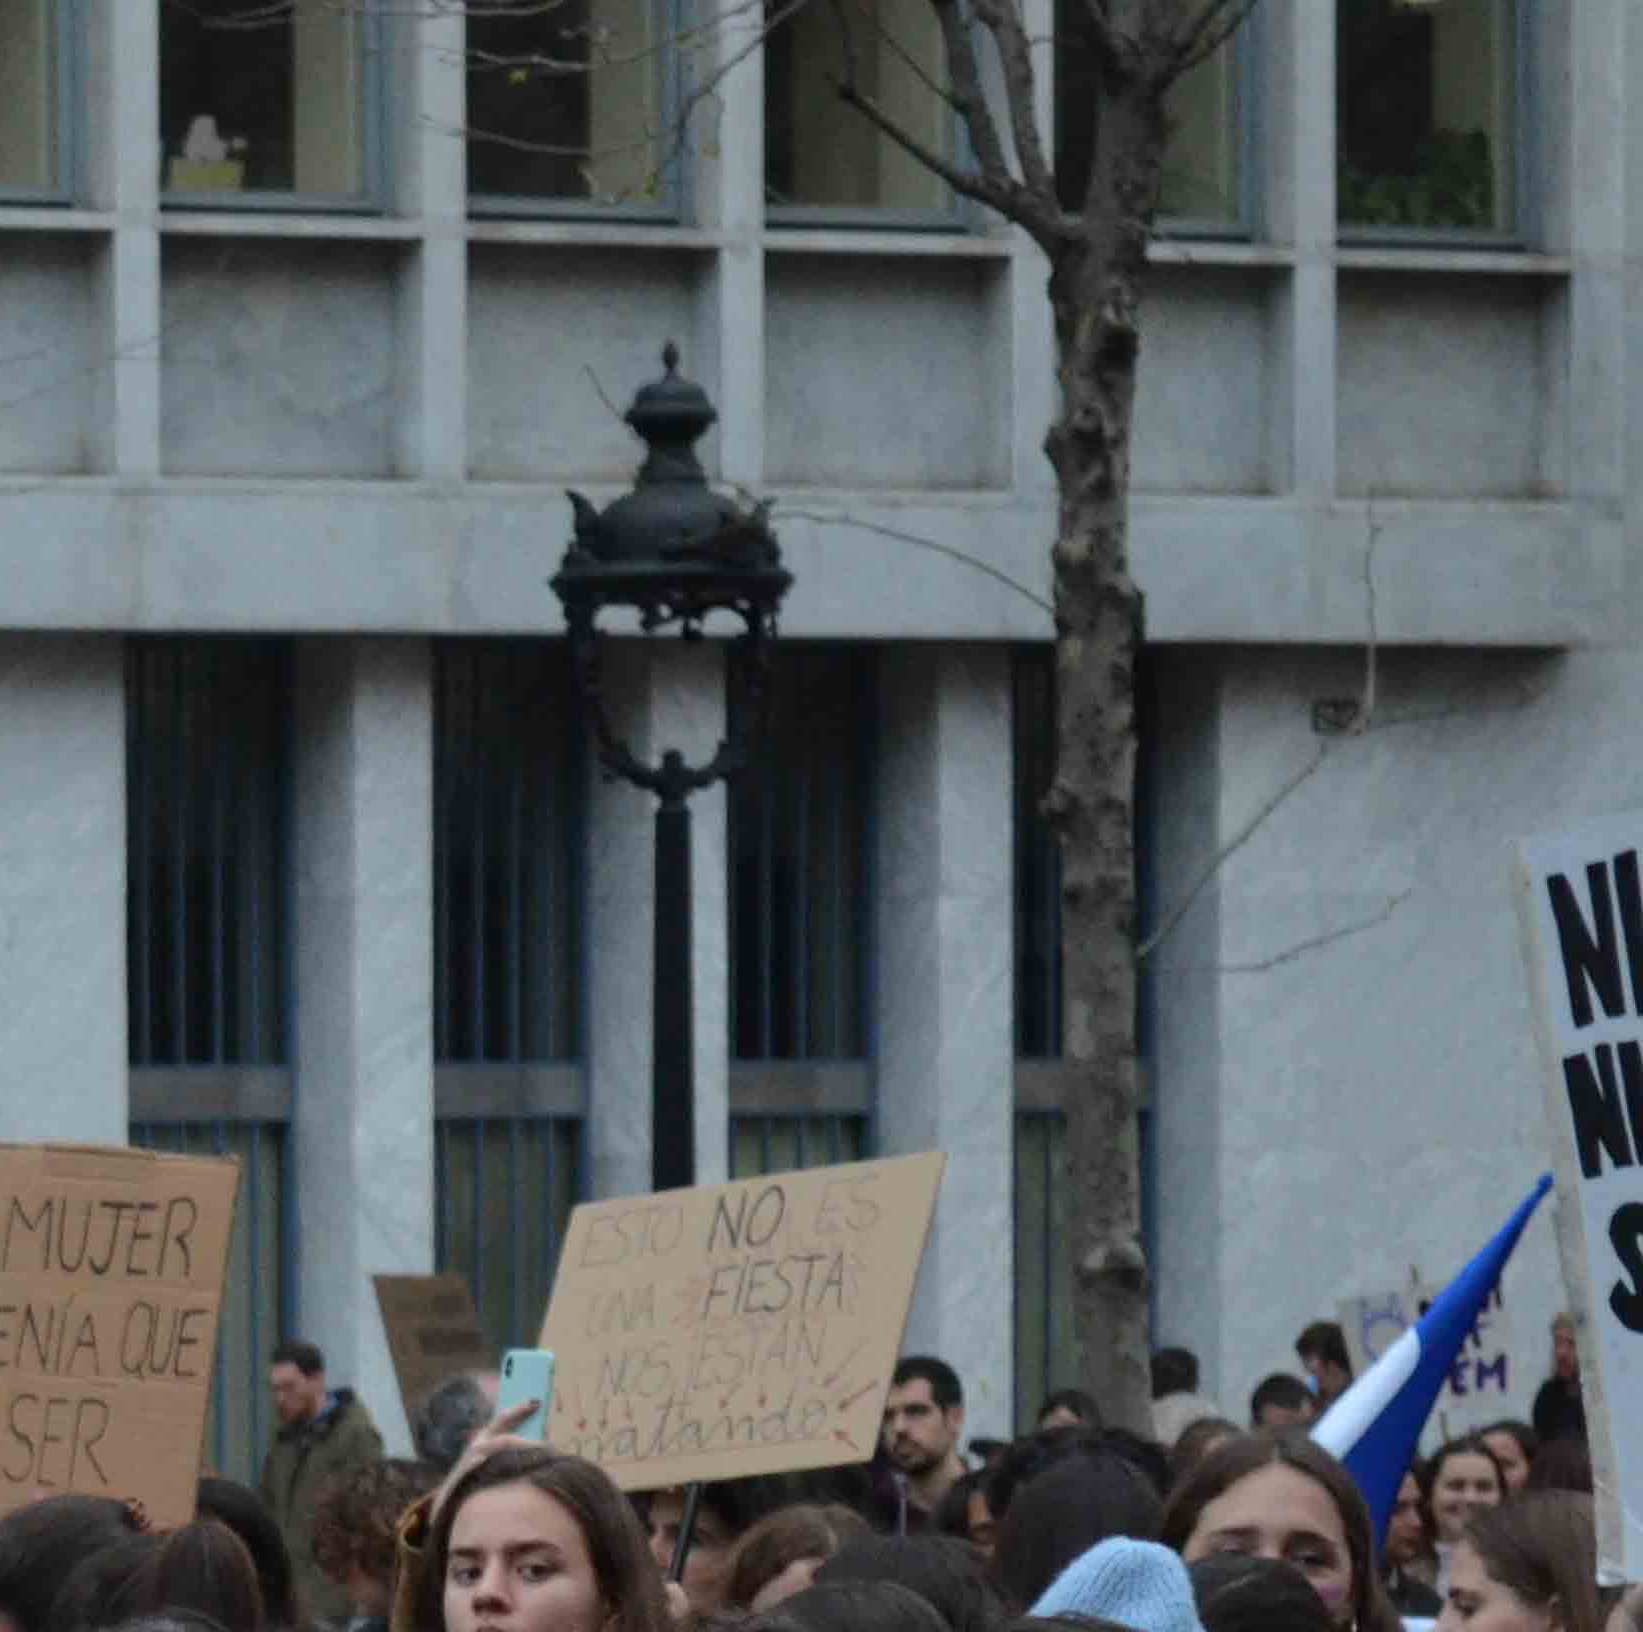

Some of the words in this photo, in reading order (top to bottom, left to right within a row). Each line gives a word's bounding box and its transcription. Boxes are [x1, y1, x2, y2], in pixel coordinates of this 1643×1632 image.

[1, 1194, 200, 1278] MUJER
[579, 1205, 685, 1268] ESTO
[707, 1184, 787, 1253] NO
[813, 1172, 882, 1237] ES
[121, 1301, 211, 1382] QUE
[1, 1392, 112, 1487] SER
